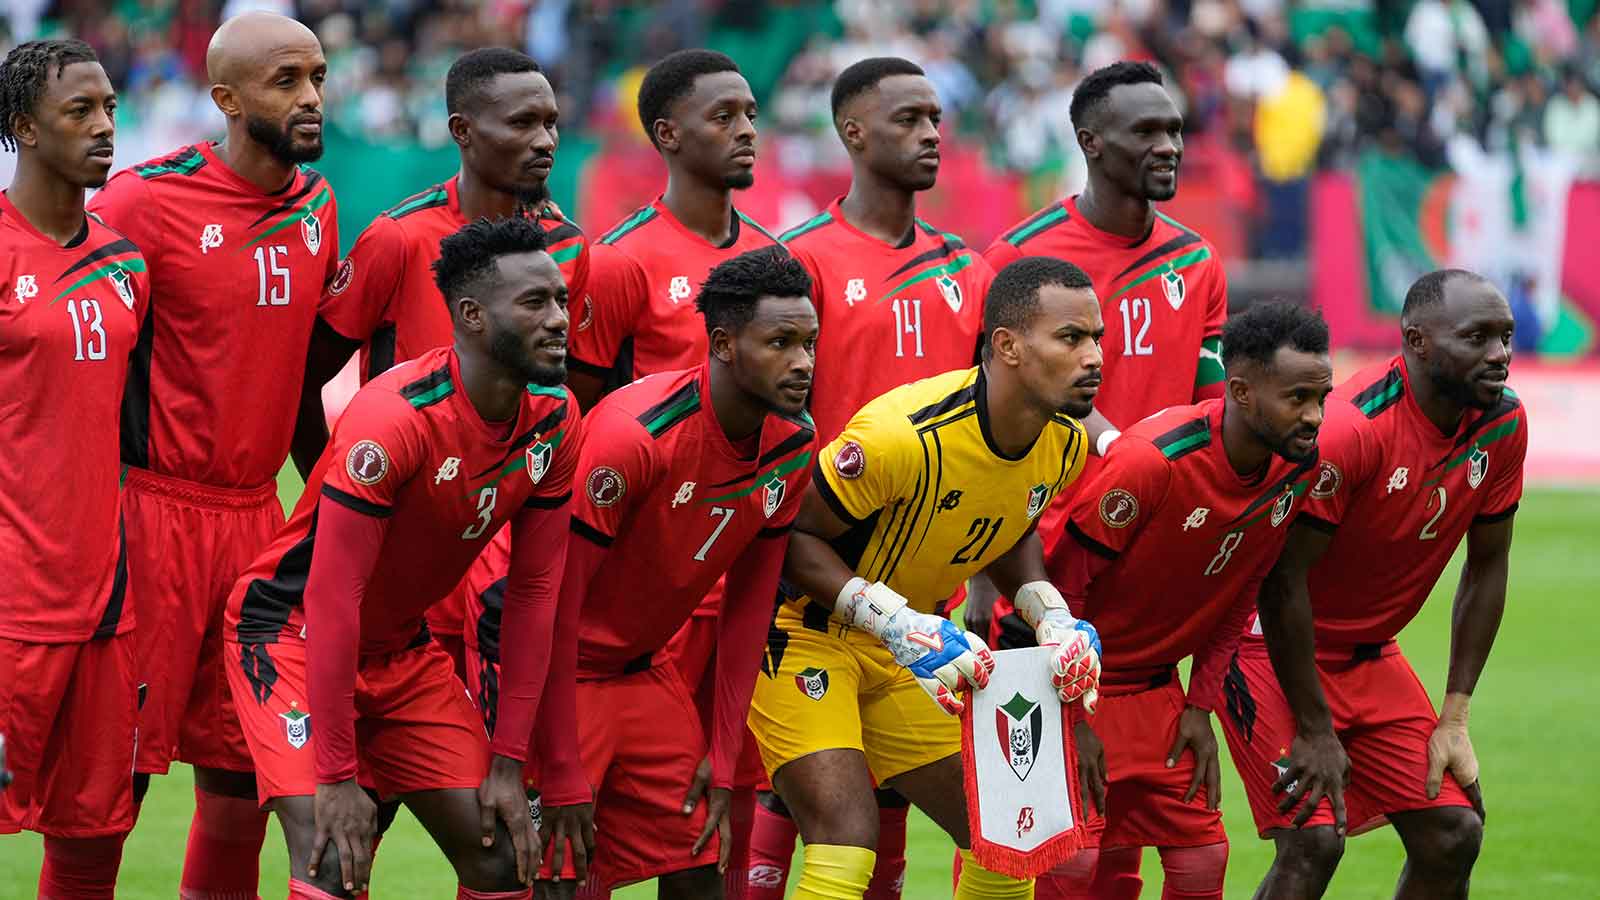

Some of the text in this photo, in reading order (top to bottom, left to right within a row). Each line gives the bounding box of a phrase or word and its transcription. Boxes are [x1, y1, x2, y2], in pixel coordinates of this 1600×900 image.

[253, 244, 291, 307] 15
[66, 298, 107, 362] 13
[891, 299, 925, 358] 14
[1118, 297, 1153, 357] 12
[461, 487, 498, 541] 3
[692, 506, 736, 562] 7
[950, 516, 1006, 565] 21
[1418, 486, 1447, 541] 2
[1203, 531, 1245, 576] 8
